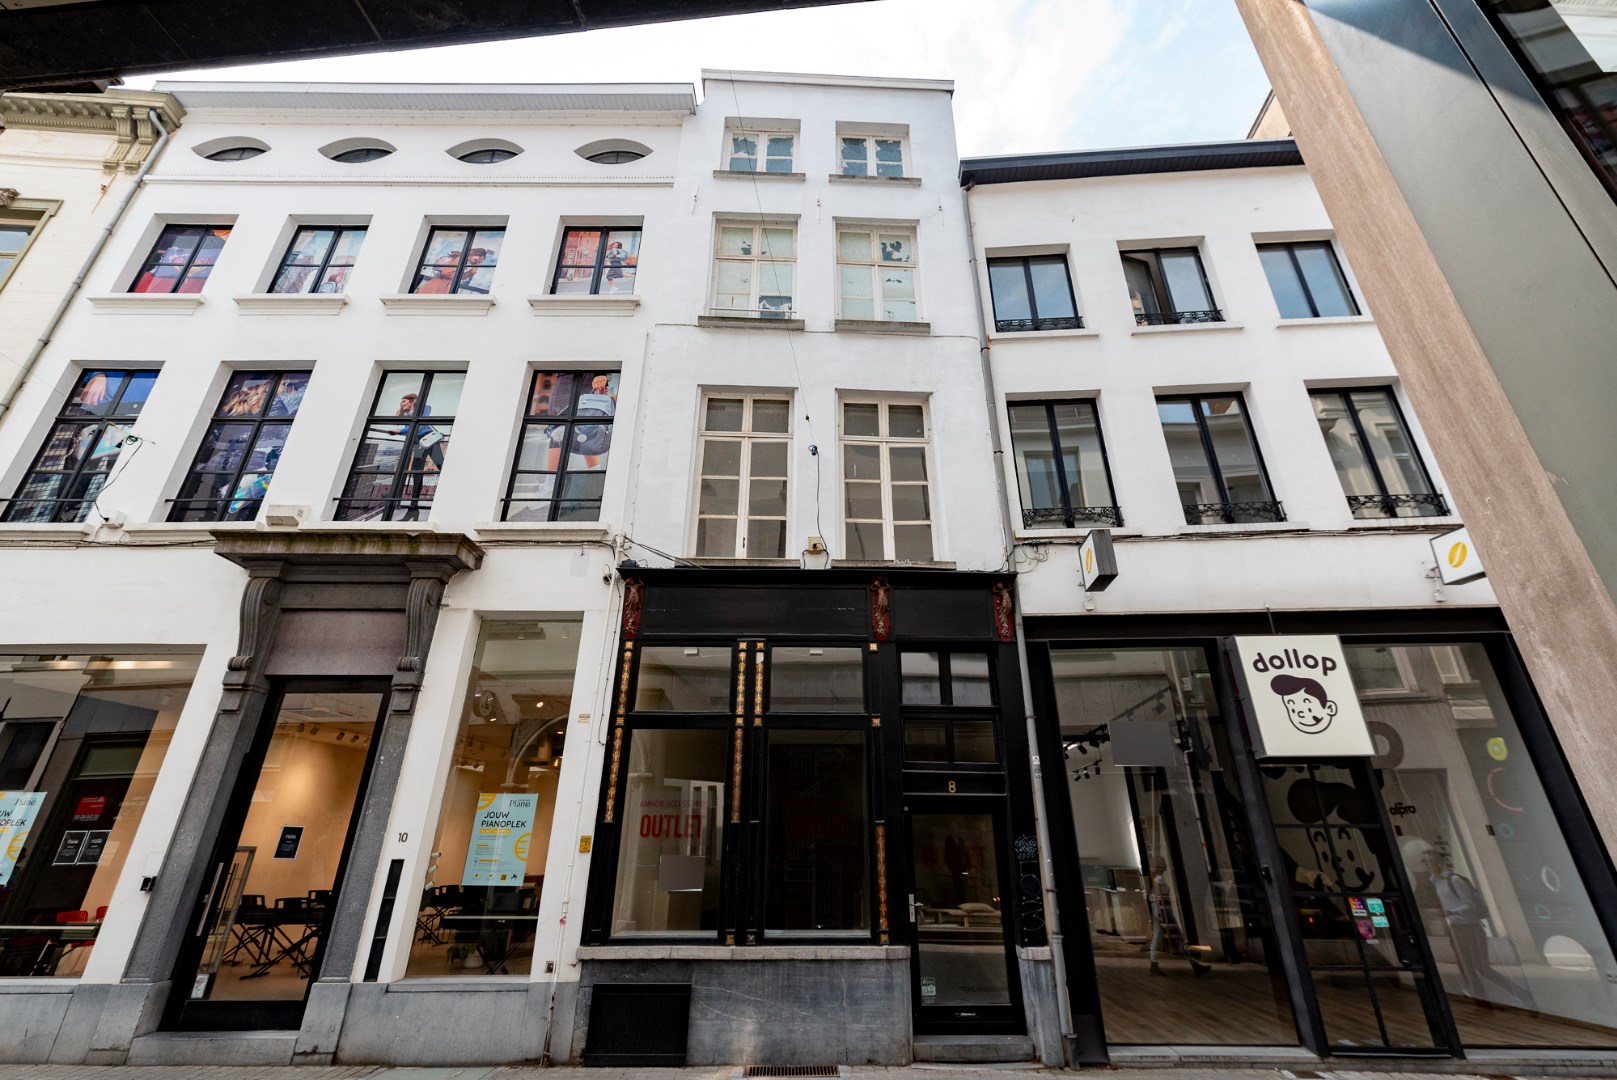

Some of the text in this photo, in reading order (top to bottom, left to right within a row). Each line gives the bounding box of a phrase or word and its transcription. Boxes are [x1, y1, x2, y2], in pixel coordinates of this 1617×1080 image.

[1252, 648, 1337, 677] dollop
[948, 780, 957, 793] 8
[509, 799, 531, 808] Piano
[484, 811, 510, 819] JOUW
[1389, 802, 1416, 818] alpro
[0, 818, 27, 827] OPLEK
[480, 820, 527, 828] PIANOPLEK
[640, 814, 706, 839] OUTLET
[398, 832, 409, 843] 10
